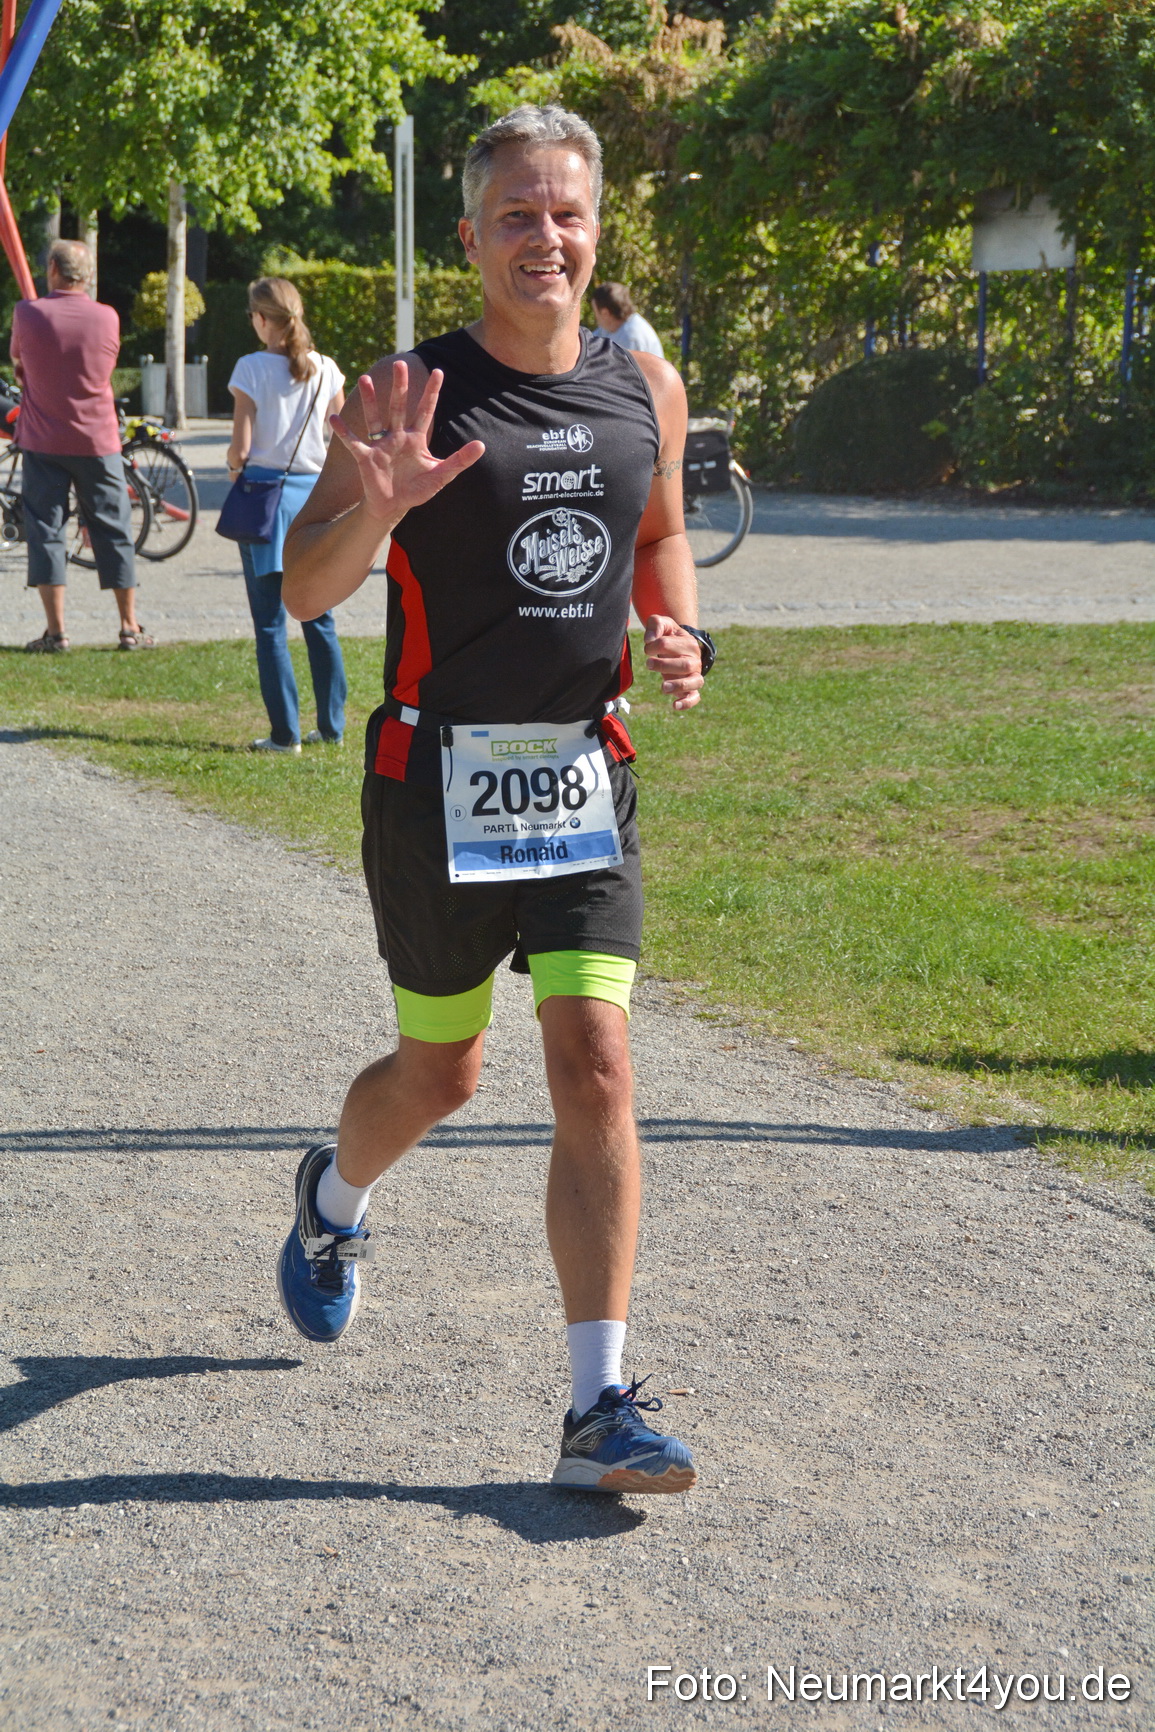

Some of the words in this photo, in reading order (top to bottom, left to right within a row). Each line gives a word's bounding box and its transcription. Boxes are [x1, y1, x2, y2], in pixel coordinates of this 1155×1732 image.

[542, 429, 565, 440] ebf
[522, 490, 604, 502] www.smart-electronic.de
[519, 517, 584, 577] Maisel's
[548, 534, 604, 578] Weisse
[518, 603, 594, 619] www.ebf.li
[491, 738, 558, 757] BOCK
[469, 765, 588, 817] 2098
[454, 809, 461, 818] D
[483, 823, 518, 834] PARTL
[520, 821, 566, 833] Neumarkt
[500, 840, 568, 865] Ronald
